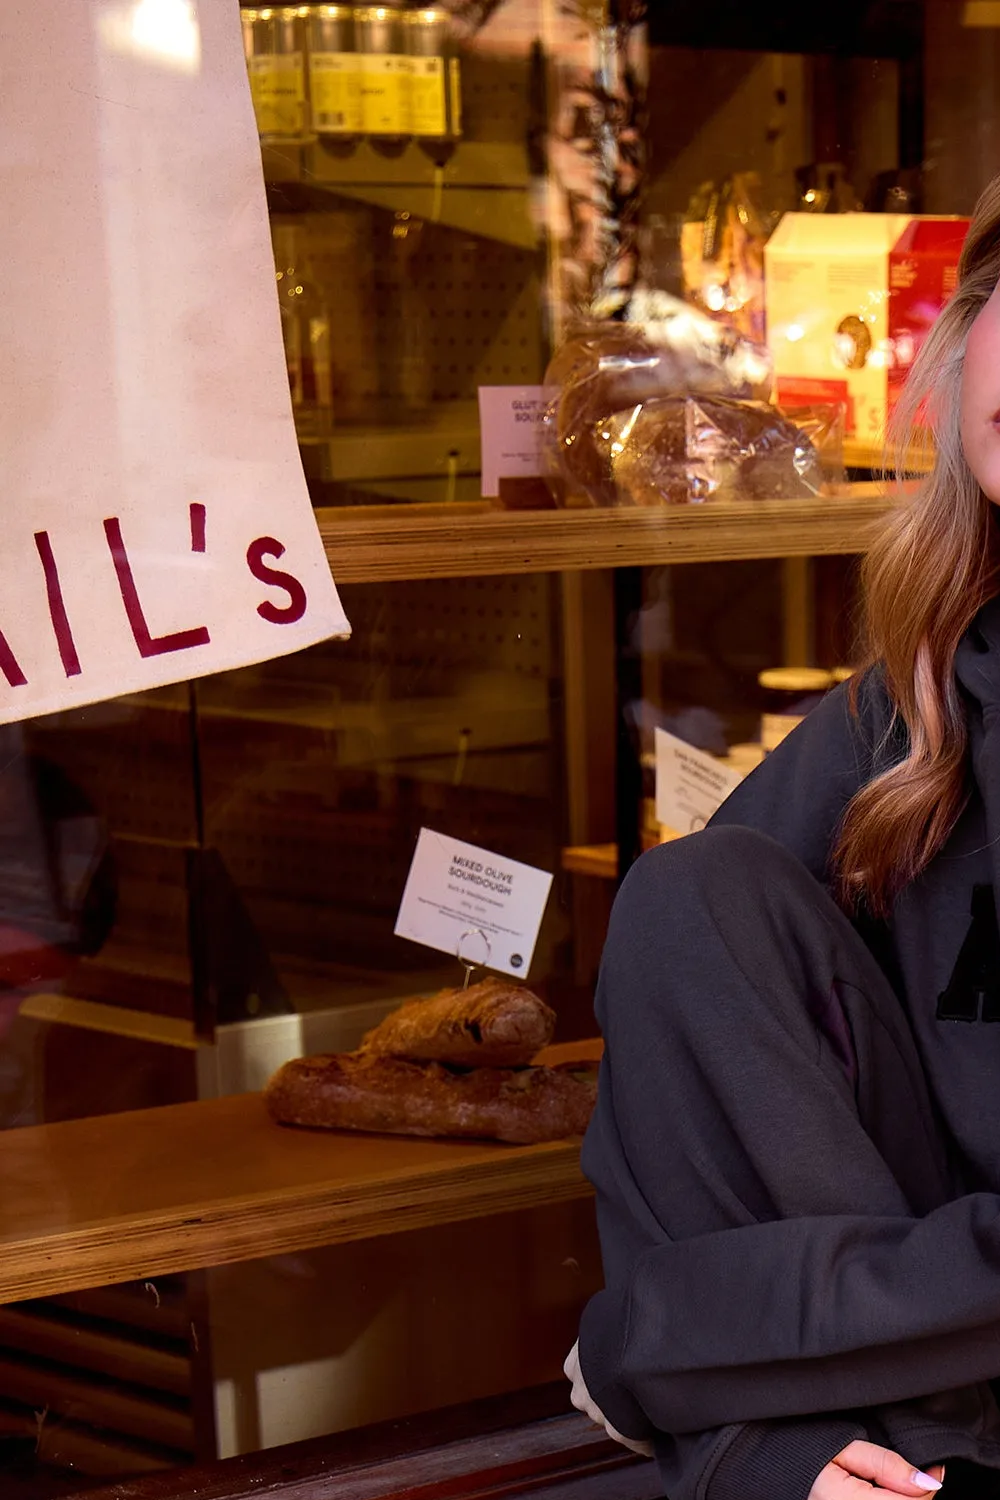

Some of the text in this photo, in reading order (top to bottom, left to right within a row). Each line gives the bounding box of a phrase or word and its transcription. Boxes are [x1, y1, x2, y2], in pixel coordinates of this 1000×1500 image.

[448, 866, 512, 896] SOURDOUGH
[452, 855, 514, 884] MIXED OLIVE
